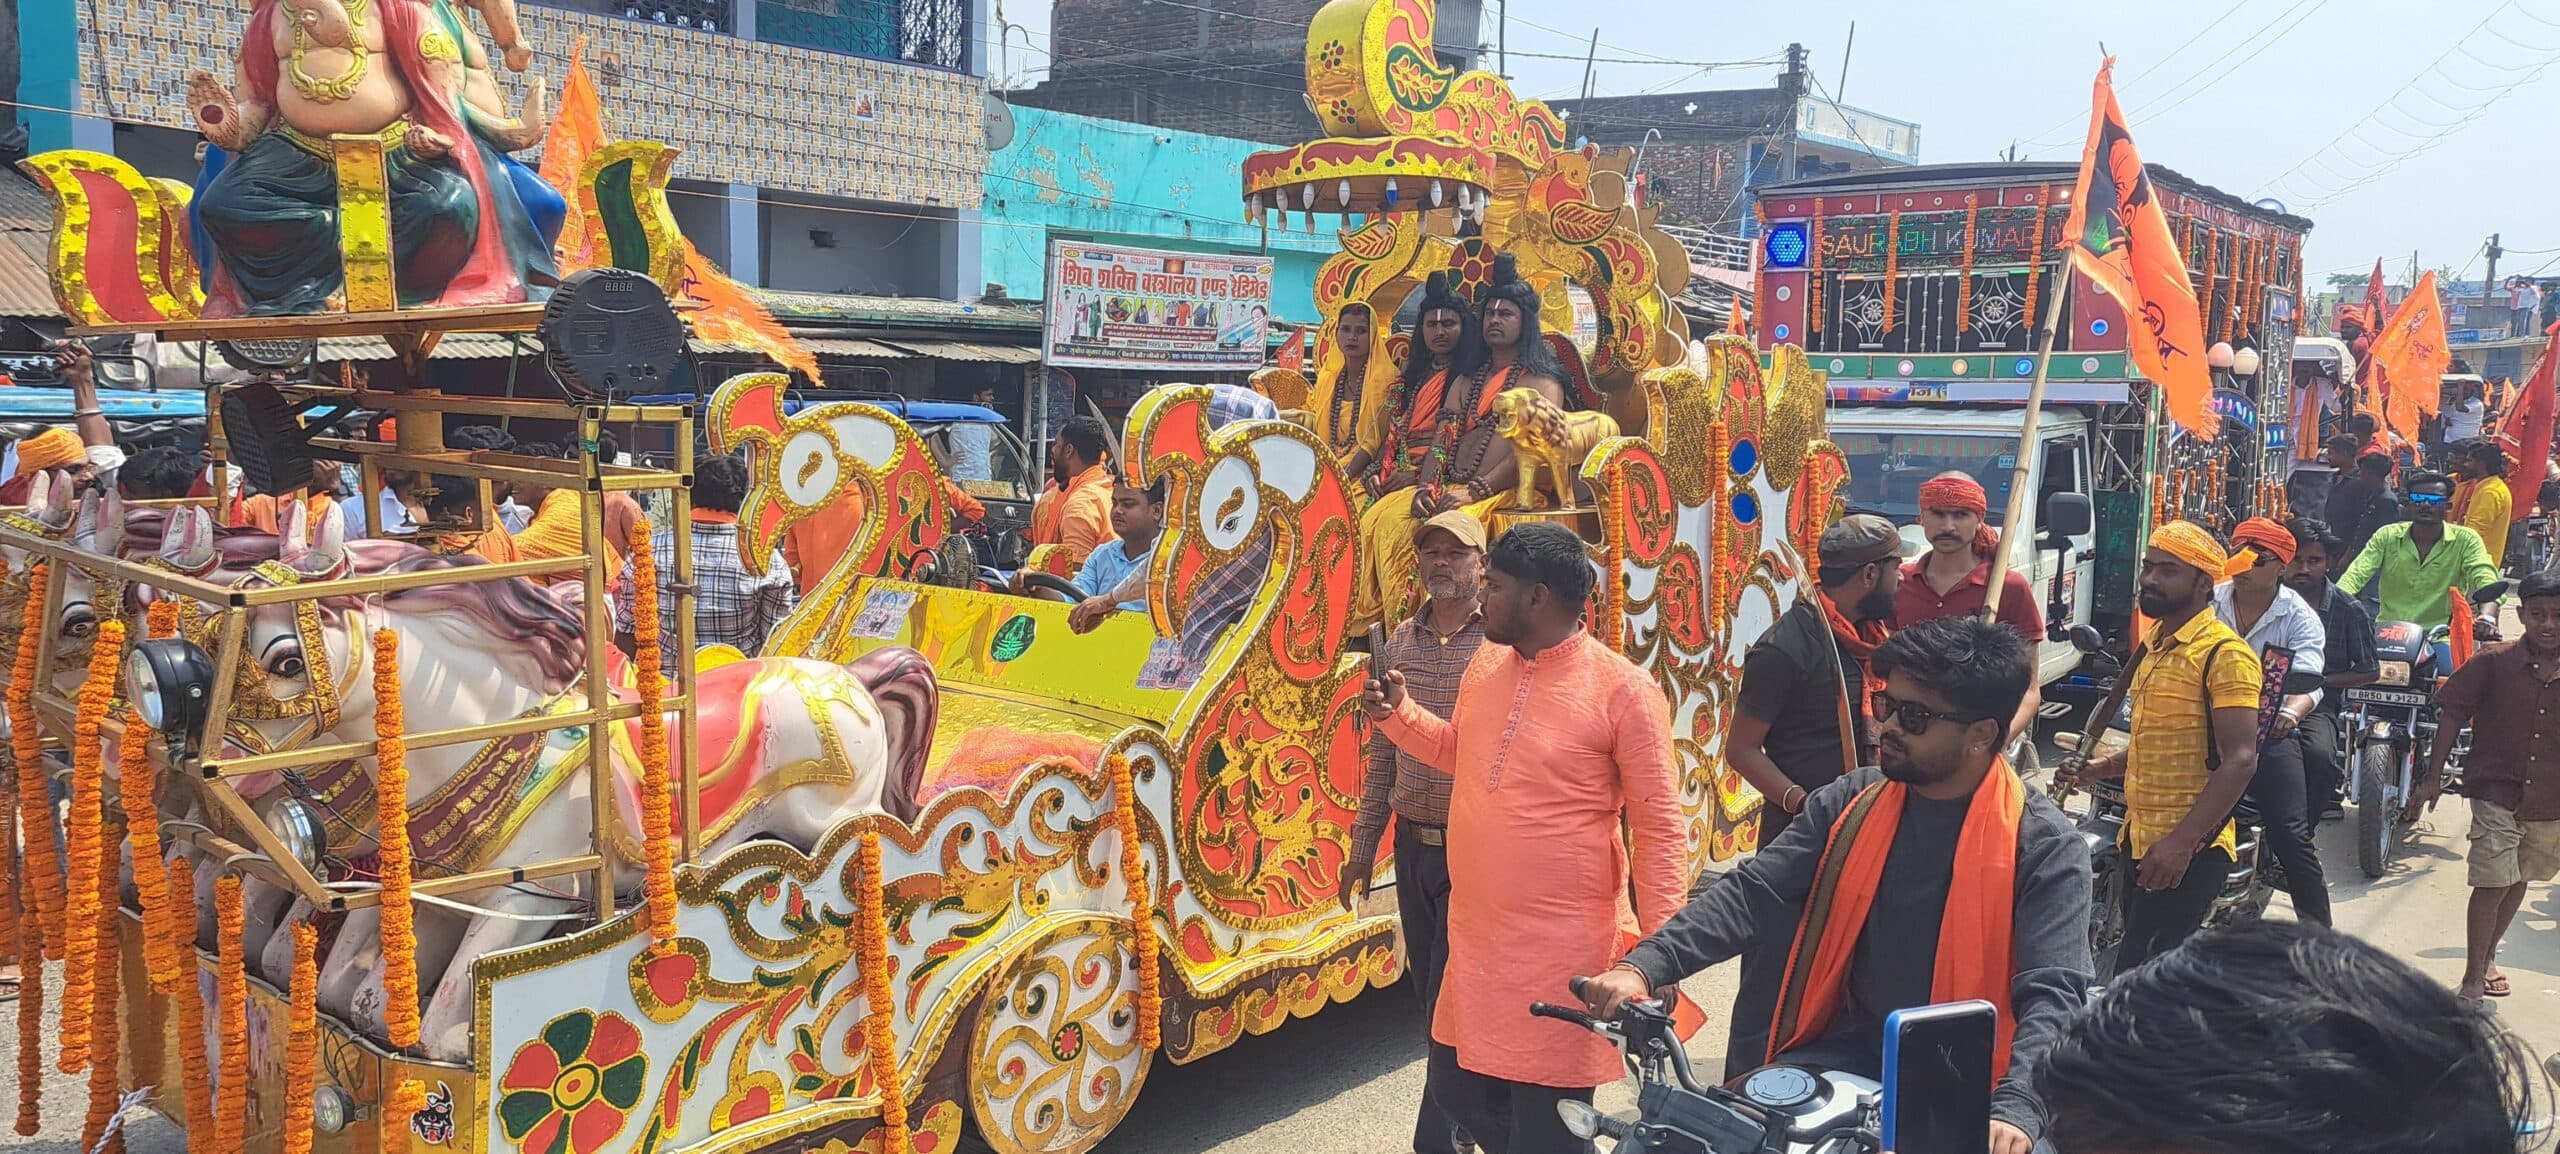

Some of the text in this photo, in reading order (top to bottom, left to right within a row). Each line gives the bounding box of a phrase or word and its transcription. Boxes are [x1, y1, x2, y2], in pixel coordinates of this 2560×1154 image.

[987, 113, 1002, 121] rtel
[1063, 258, 1093, 288] शिव
[1097, 264, 1138, 292] शक्ति
[1142, 272, 1197, 296] वस्त्रालय
[1201, 277, 1228, 297] एण्ड
